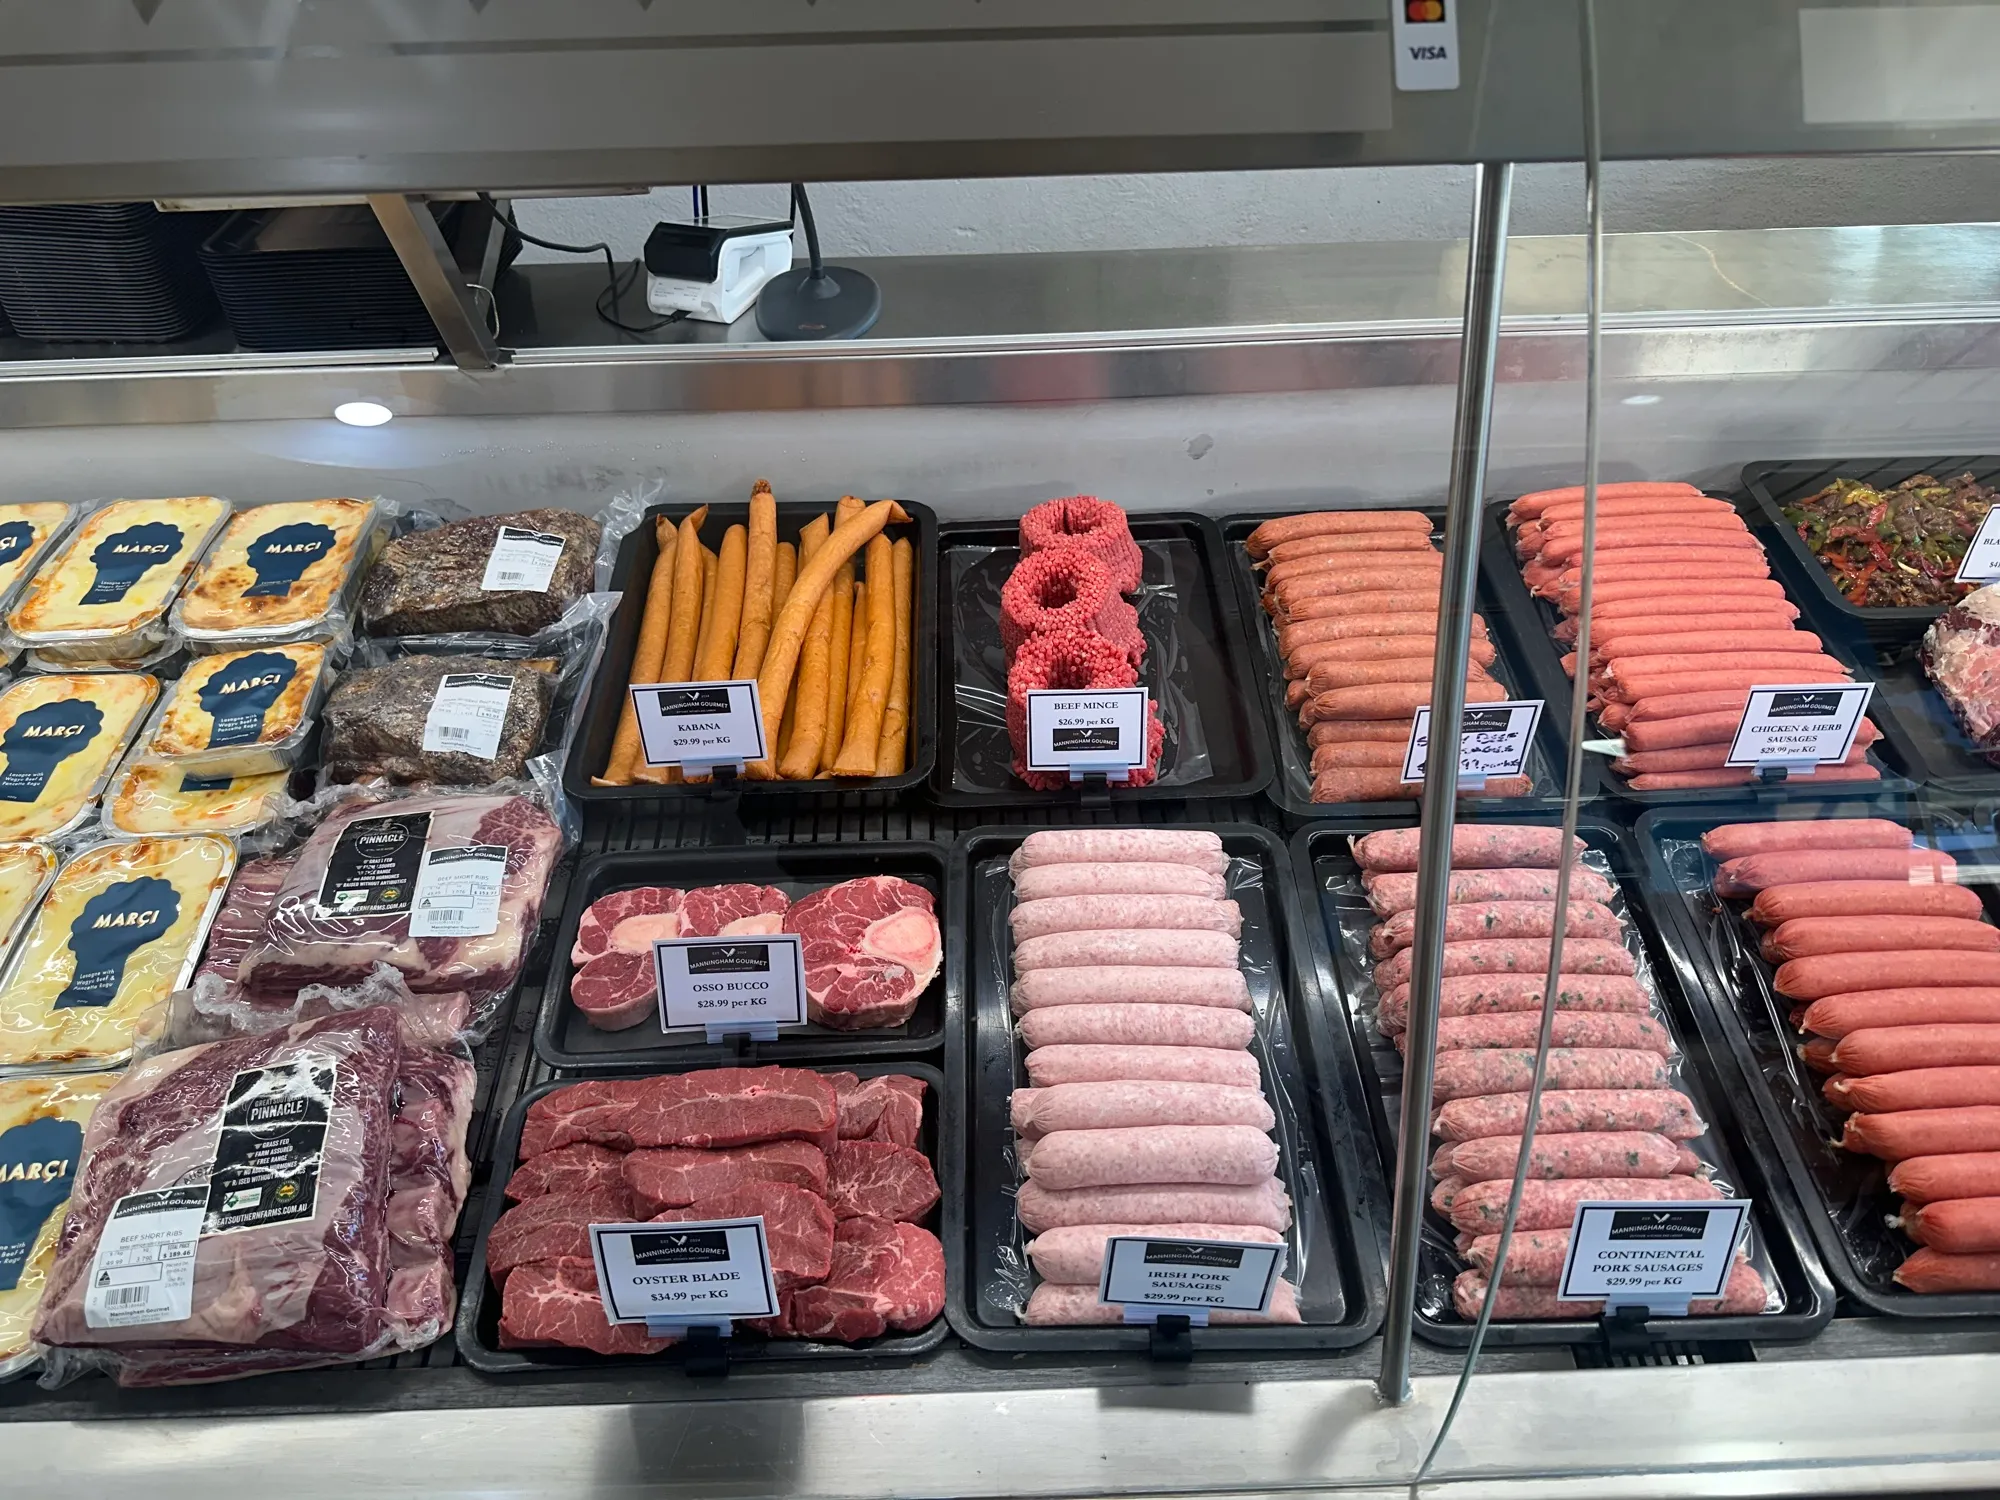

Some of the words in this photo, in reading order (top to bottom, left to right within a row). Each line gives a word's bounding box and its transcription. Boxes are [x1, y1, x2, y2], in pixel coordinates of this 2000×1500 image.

[1409, 46, 1447, 60] VISA
[113, 544, 169, 554] MARÇI
[264, 541, 322, 553] MARÇI
[218, 674, 281, 694] MARÇI
[661, 702, 700, 712] MANNINGHAM
[700, 701, 728, 709] GOURMET
[1053, 702, 1081, 710] BEEF
[1083, 701, 1119, 709] MINCE
[1770, 704, 1810, 712] MANNINGHAM
[1058, 718, 1085, 726] $26.99
[1100, 717, 1114, 725] KG
[22, 725, 85, 738] MARÇI
[677, 723, 721, 732] KABANA
[1750, 725, 1800, 733] CHICKEN
[1812, 723, 1842, 731] HERB
[673, 737, 700, 746] $29.99
[702, 738, 714, 746] per
[716, 736, 731, 744] KG
[1053, 738, 1090, 747] MANNINGHAM
[1091, 738, 1118, 746] GOURMET
[1766, 735, 1818, 743] SAUSAGES
[1760, 746, 1787, 754] $29.99
[1787, 747, 1800, 755] per
[1801, 745, 1816, 753] KG
[359, 834, 405, 844] PINNACLE
[430, 853, 473, 864] MANNINGHAM
[91, 910, 160, 929] MARÇI
[690, 958, 734, 969] MANNINGHAM
[735, 958, 767, 966] GOURMET
[80, 971, 101, 979] Lasagne
[692, 983, 724, 992] OSSO
[727, 981, 769, 991] BUCCO
[697, 999, 729, 1009] $28.99
[731, 1001, 748, 1009] per
[751, 997, 767, 1006] KG
[251, 1100, 303, 1121] PINNACLE
[270, 1146, 293, 1155] ASSURED
[271, 1155, 288, 1163] RANGE
[116, 1200, 168, 1217] MANNINGHAM
[1612, 1225, 1665, 1235] MANNINGHAM
[1666, 1225, 1703, 1234] GOURMET
[120, 1234, 139, 1243] BEEF
[140, 1231, 165, 1241] SHORT
[11, 1242, 26, 1250] with
[635, 1247, 688, 1259] MANNINGHAM
[688, 1247, 727, 1255] GOURMET
[1598, 1250, 1705, 1259] CONTINENTAL
[1200, 1255, 1238, 1264] GOURMET
[1592, 1264, 1633, 1273] PORK
[1634, 1263, 1704, 1272] SAUSAGES
[632, 1272, 689, 1286] OYSTER
[692, 1271, 741, 1283] BLADE
[1148, 1271, 1187, 1279] IRISH
[1192, 1273, 1231, 1282] PORK
[1605, 1277, 1642, 1286] $29.99
[1644, 1279, 1661, 1287] per
[1663, 1276, 1683, 1285] KG
[1151, 1281, 1223, 1291] SAUSAGES
[651, 1292, 687, 1302] $34.99
[690, 1293, 707, 1302] per
[709, 1289, 729, 1299] KG
[1144, 1292, 1180, 1301] $29.99
[1183, 1295, 1202, 1303] per
[1205, 1295, 1225, 1304] KG
[110, 1309, 145, 1317] Manningham
